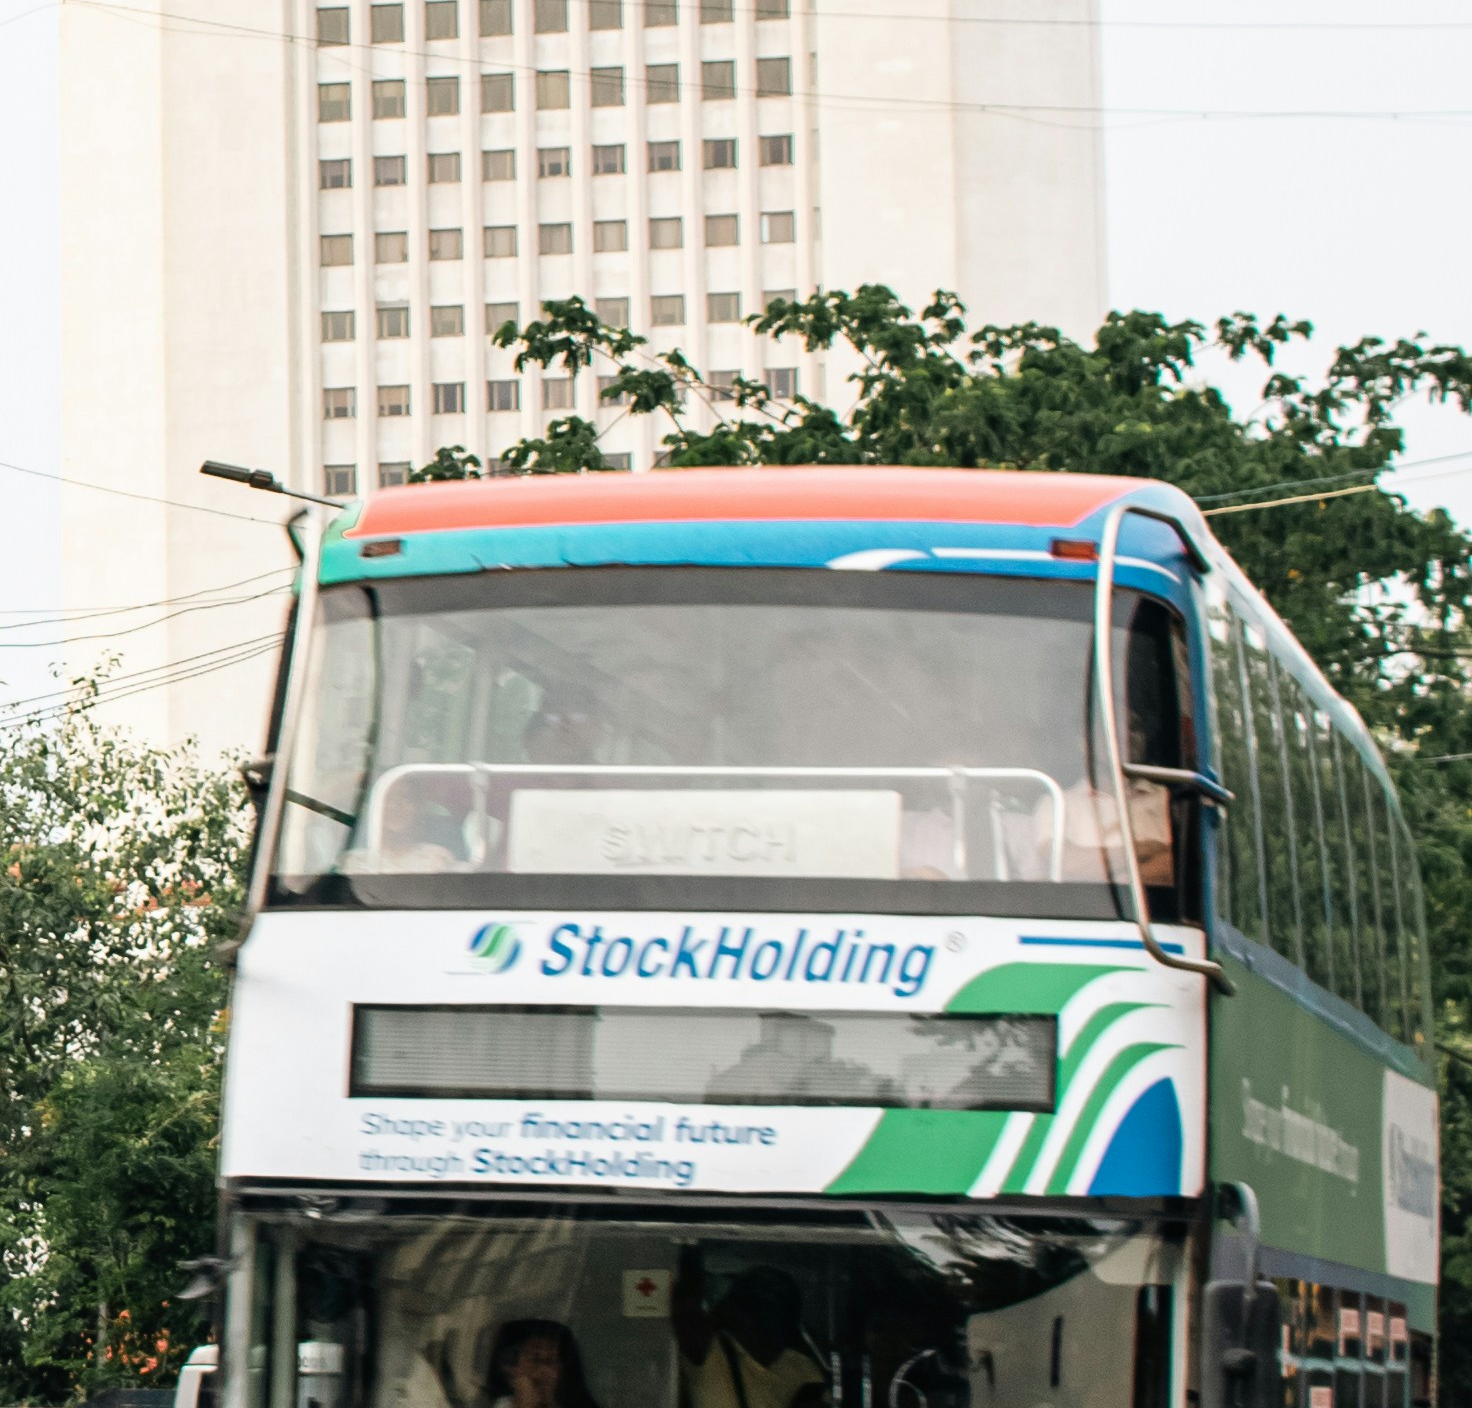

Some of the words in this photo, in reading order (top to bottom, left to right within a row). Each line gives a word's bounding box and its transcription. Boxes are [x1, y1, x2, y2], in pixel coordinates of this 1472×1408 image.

[602, 824, 796, 863] SWITCH
[539, 922, 936, 997] StockHolding
[360, 1112, 446, 1141] Shape
[451, 1119, 512, 1143] your
[520, 1112, 664, 1143] financial
[675, 1116, 778, 1146] future
[359, 1149, 466, 1179] through
[471, 1149, 696, 1187] StockHolding
